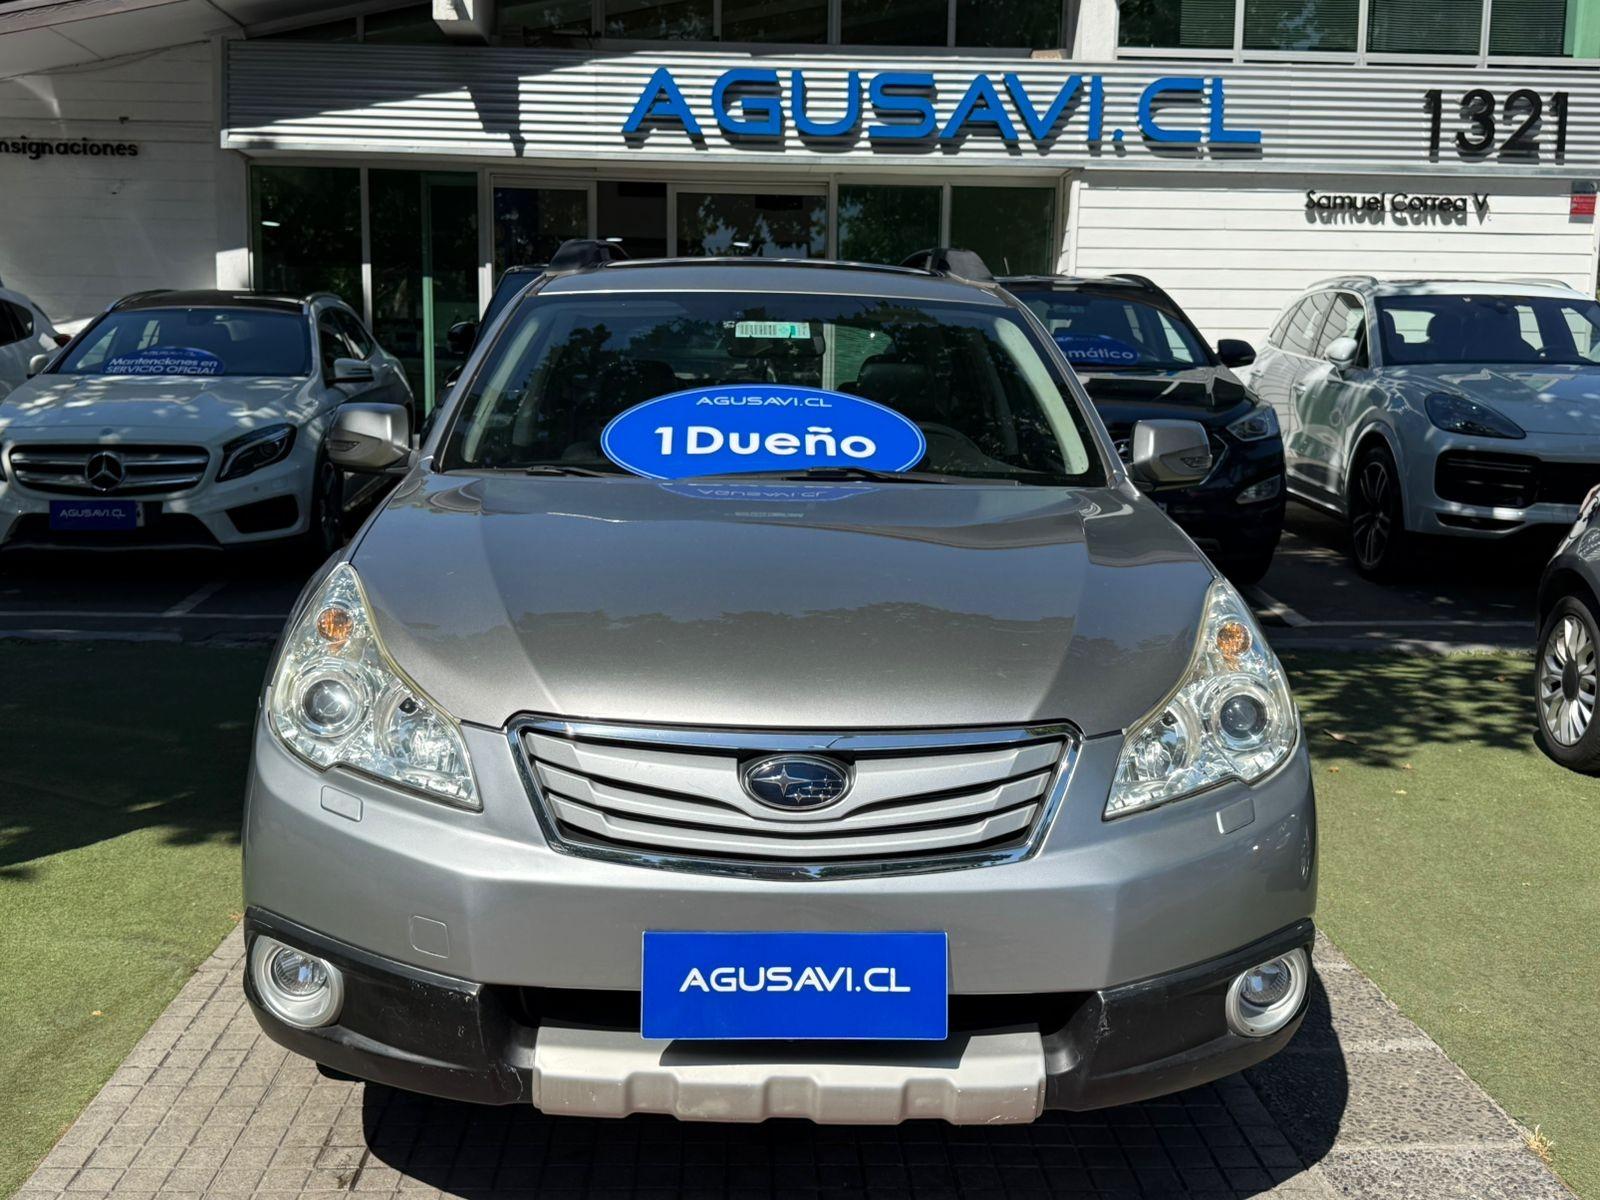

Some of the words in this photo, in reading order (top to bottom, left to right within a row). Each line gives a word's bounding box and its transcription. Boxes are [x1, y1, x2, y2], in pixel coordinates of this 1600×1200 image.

[622, 67, 1262, 144] AGUSAVI.CL
[1423, 89, 1569, 157] 1321
[0, 136, 138, 160] nsignaciones
[1304, 189, 1386, 212] Samuel
[1391, 192, 1467, 213] Correa
[105, 365, 164, 374] SERVICIO
[200, 360, 218, 368] en
[696, 397, 832, 408] AGUSAVI.CL
[654, 426, 673, 456] 1
[686, 426, 877, 459] Dueño
[679, 967, 911, 993] AGUSAVI.CL
